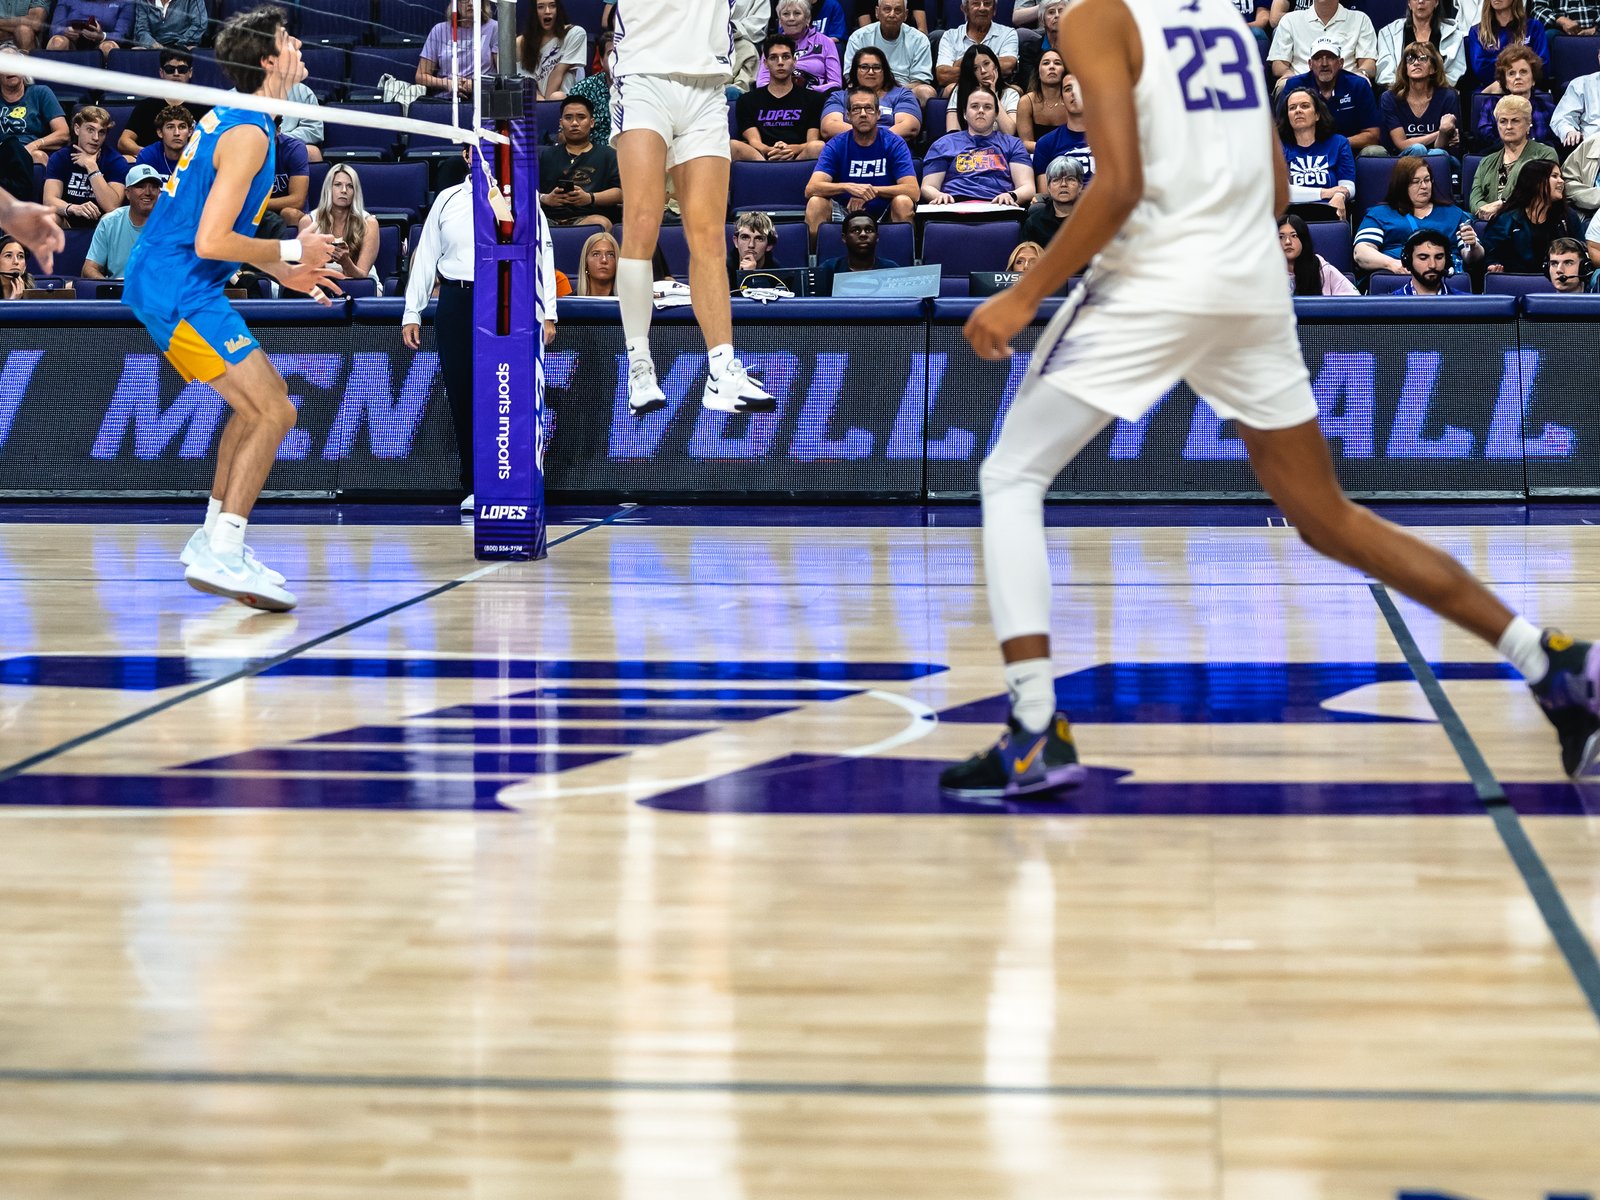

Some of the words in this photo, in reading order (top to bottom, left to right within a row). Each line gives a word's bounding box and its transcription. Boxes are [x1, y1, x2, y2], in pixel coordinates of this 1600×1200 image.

[1163, 27, 1260, 111] 23
[758, 109, 802, 121] LOPES
[1407, 123, 1435, 133] GCU
[849, 157, 888, 178] GCU
[68, 172, 92, 191] GC
[1292, 171, 1328, 186] GCU
[994, 273, 1025, 283] DVS
[496, 363, 512, 414] sports
[607, 350, 1574, 461] VOLLALL
[480, 505, 528, 520] LOPES
[484, 545, 499, 553] (800)
